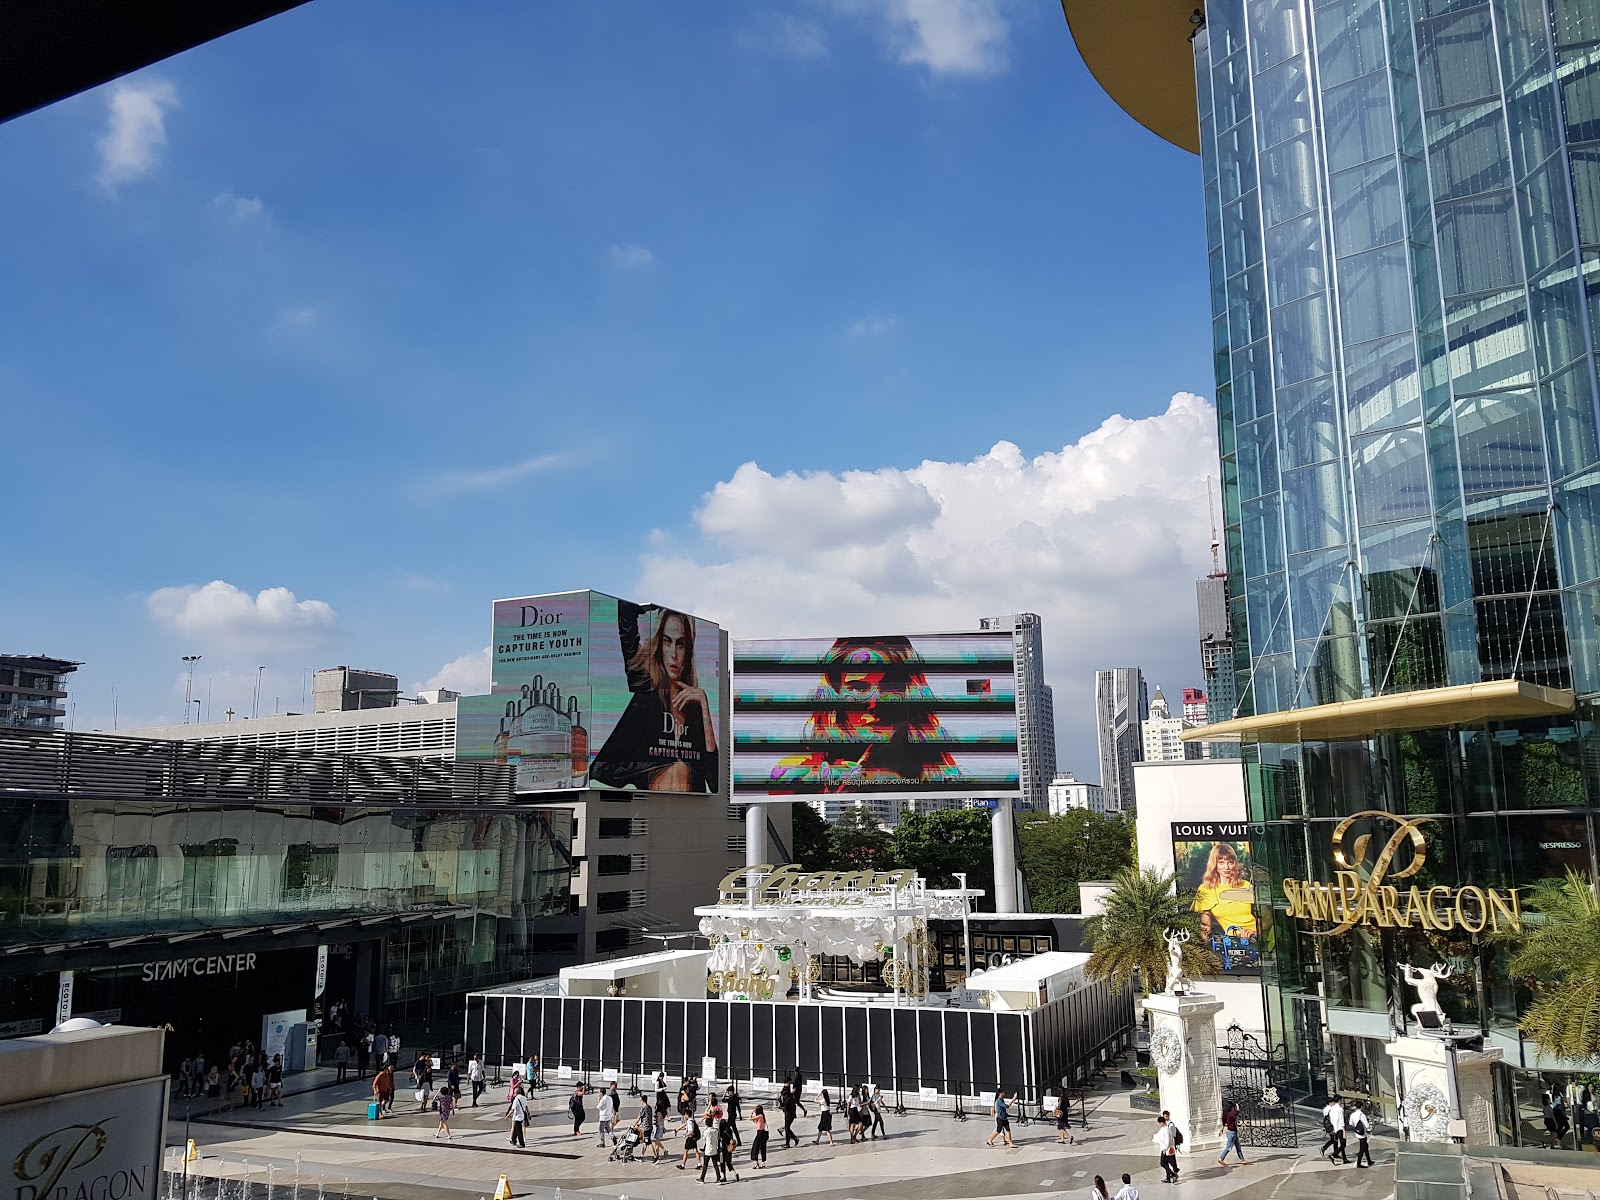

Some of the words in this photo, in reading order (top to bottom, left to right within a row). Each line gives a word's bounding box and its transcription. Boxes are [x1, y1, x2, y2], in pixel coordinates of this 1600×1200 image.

[519, 605, 563, 628] Dior
[513, 634, 525, 642] THE
[526, 632, 542, 640] TIME
[552, 629, 568, 638] NOW
[498, 641, 545, 654] CAPTURE
[549, 637, 582, 649] YOUTH
[662, 711, 689, 736] Dior
[658, 738, 667, 746] THE
[683, 741, 692, 749] NOW
[648, 746, 679, 758] CAPTURE
[680, 750, 701, 760] YOUTH
[532, 775, 545, 783] Dior
[973, 799, 989, 807] Plan
[1175, 825, 1214, 836] LOUIS
[1539, 841, 1582, 850] NESPRESSO
[718, 863, 918, 897] Chang
[1282, 877, 1341, 924] SIAM
[1333, 870, 1522, 934] PARAGON
[329, 942, 353, 955] ublic
[142, 960, 188, 982] SIAM
[192, 952, 257, 976] CENTER
[707, 970, 776, 1000] Chang
[16, 1165, 148, 1200] RAGON
